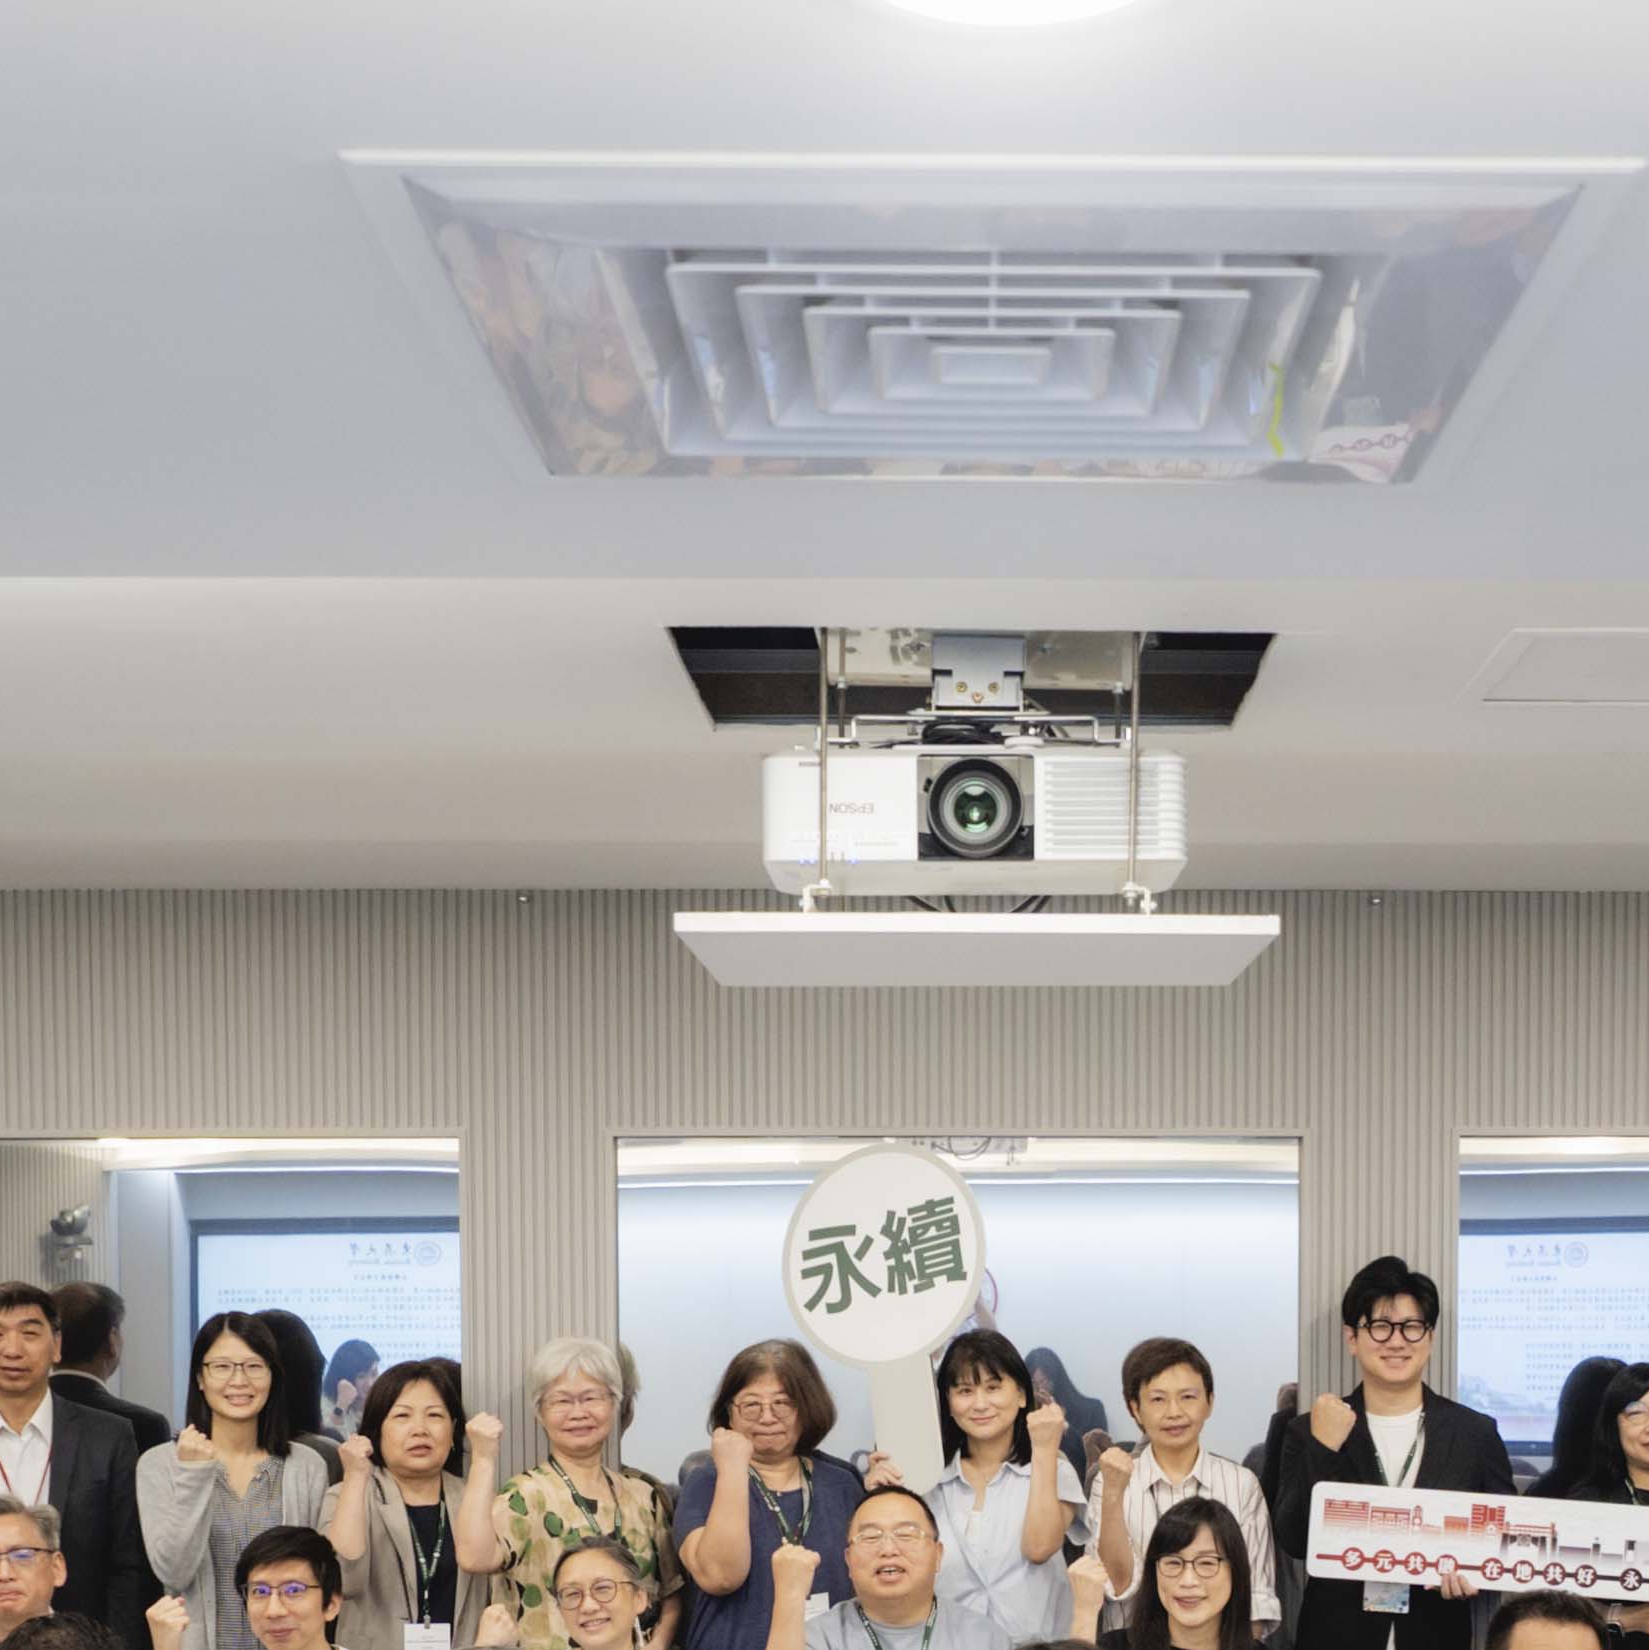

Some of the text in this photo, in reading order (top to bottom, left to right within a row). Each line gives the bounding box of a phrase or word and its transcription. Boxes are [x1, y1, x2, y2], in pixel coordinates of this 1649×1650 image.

[829, 802, 875, 815] EPSON
[800, 1196, 967, 1314] 永續
[1484, 1560, 1594, 1586] 在地共好
